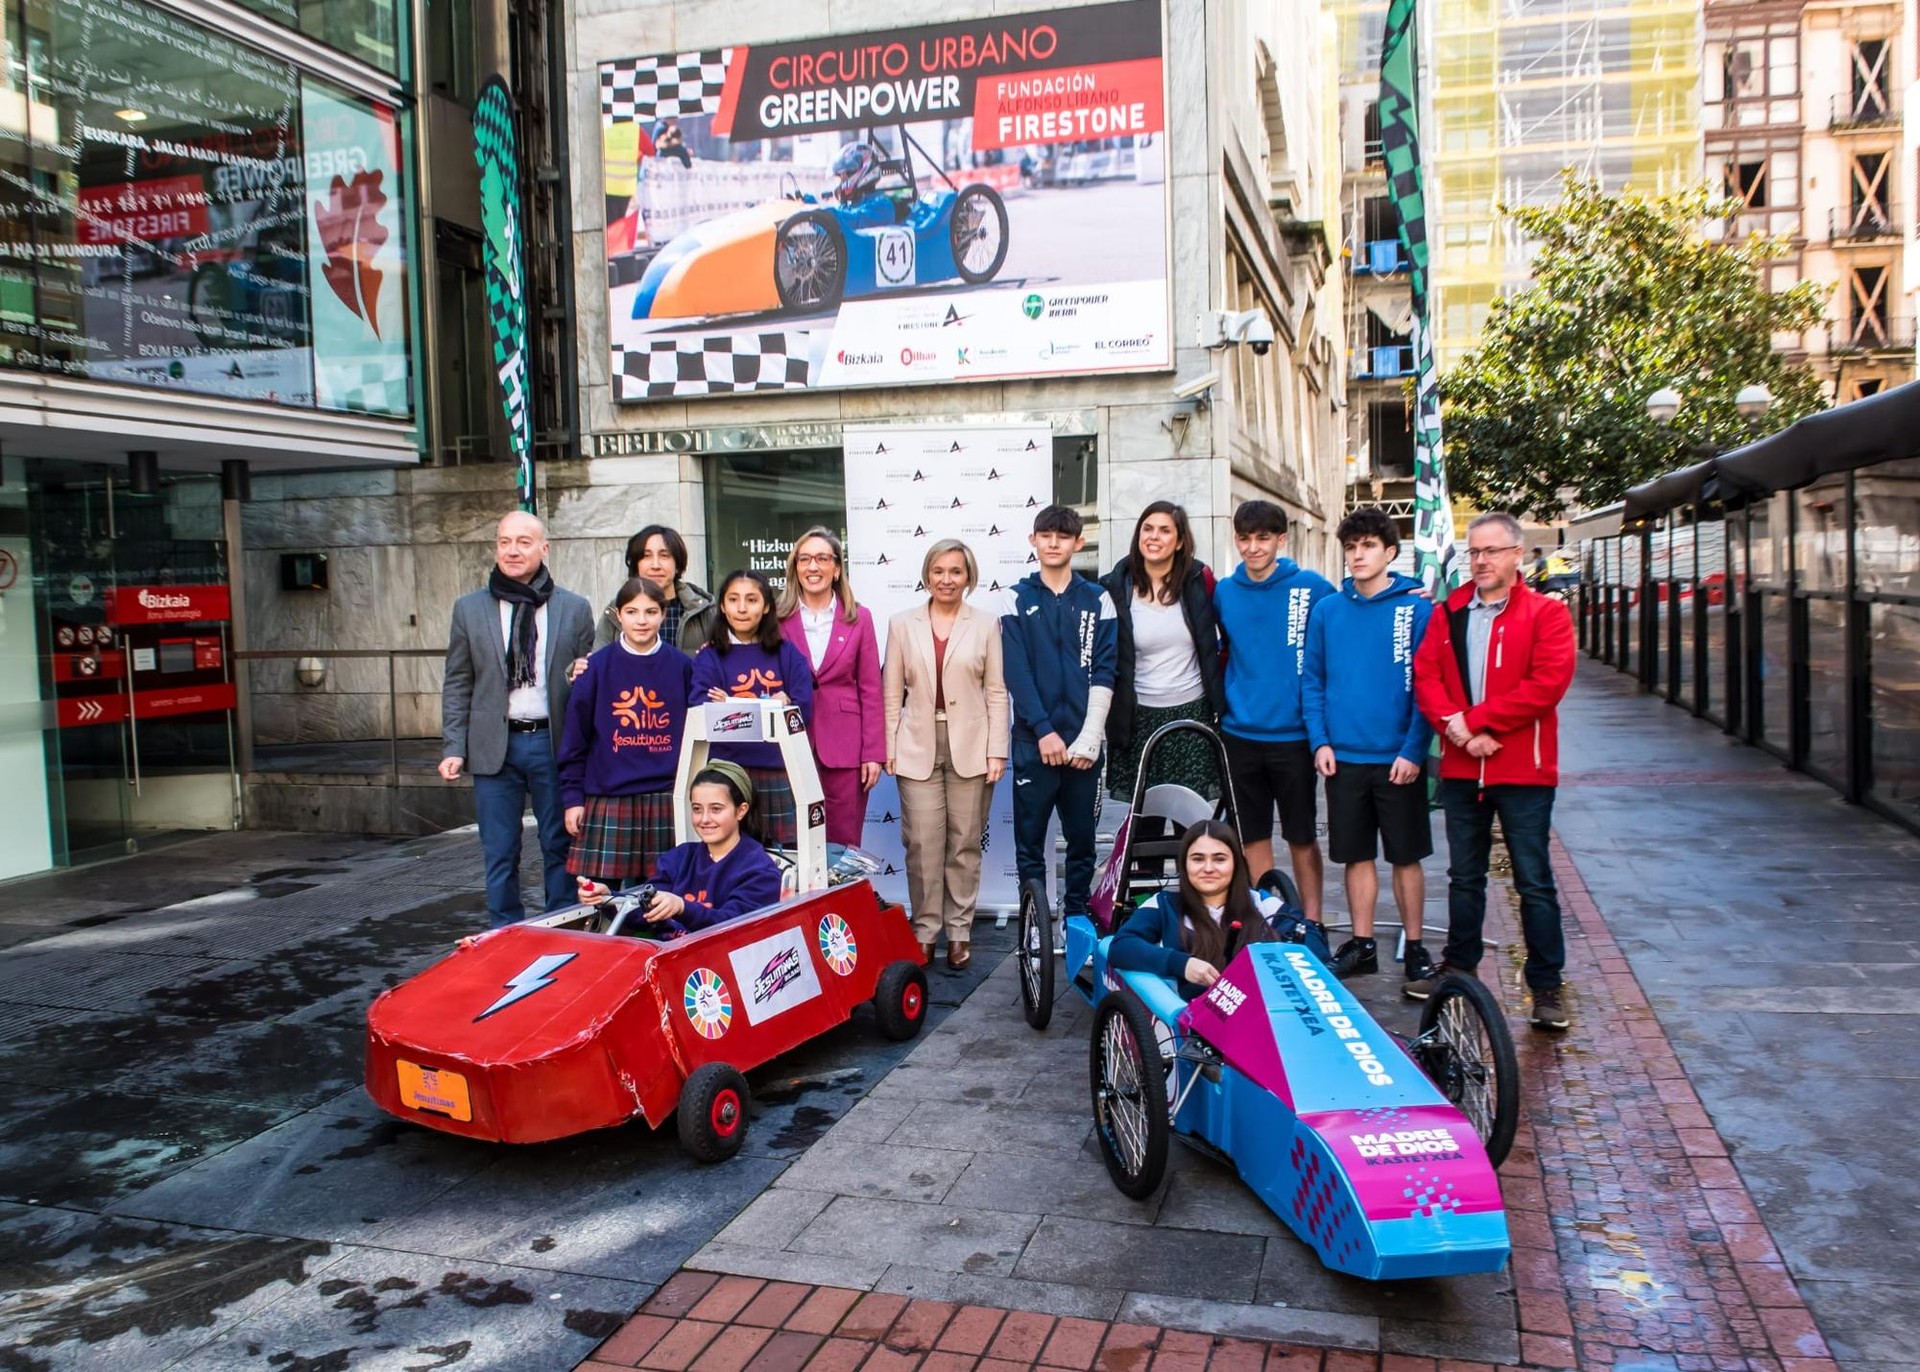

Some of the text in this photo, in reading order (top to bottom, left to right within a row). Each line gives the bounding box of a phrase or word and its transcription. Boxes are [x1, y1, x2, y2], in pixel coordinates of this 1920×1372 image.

[768, 25, 1057, 90] CIRCUITO URBANO
[997, 70, 1096, 100] FUNDACIÓN
[759, 75, 960, 128] GREENPOWER
[997, 95, 1062, 114] ALFONSO
[999, 102, 1145, 142] FIRESTONE
[886, 241, 906, 266] 41
[901, 348, 936, 366] Bilbao
[1095, 338, 1150, 350] EL CORREO
[844, 351, 883, 365] Bizkaia
[769, 577, 787, 590] ag
[147, 593, 190, 608] Bizkaia
[1298, 588, 1311, 632] MADRE
[1085, 612, 1096, 659] MADRE
[1207, 988, 1221, 1002] DE
[1215, 994, 1238, 1016] DIOS
[1217, 978, 1247, 1006] MADRE
[1261, 952, 1325, 1036] IKASTETXEA
[1284, 951, 1394, 1086] MADRE DE DIOS
[1349, 1128, 1453, 1145] MADRE
[1357, 1139, 1460, 1157] DE DIOS
[1366, 1152, 1465, 1166] IKASTETXEA
